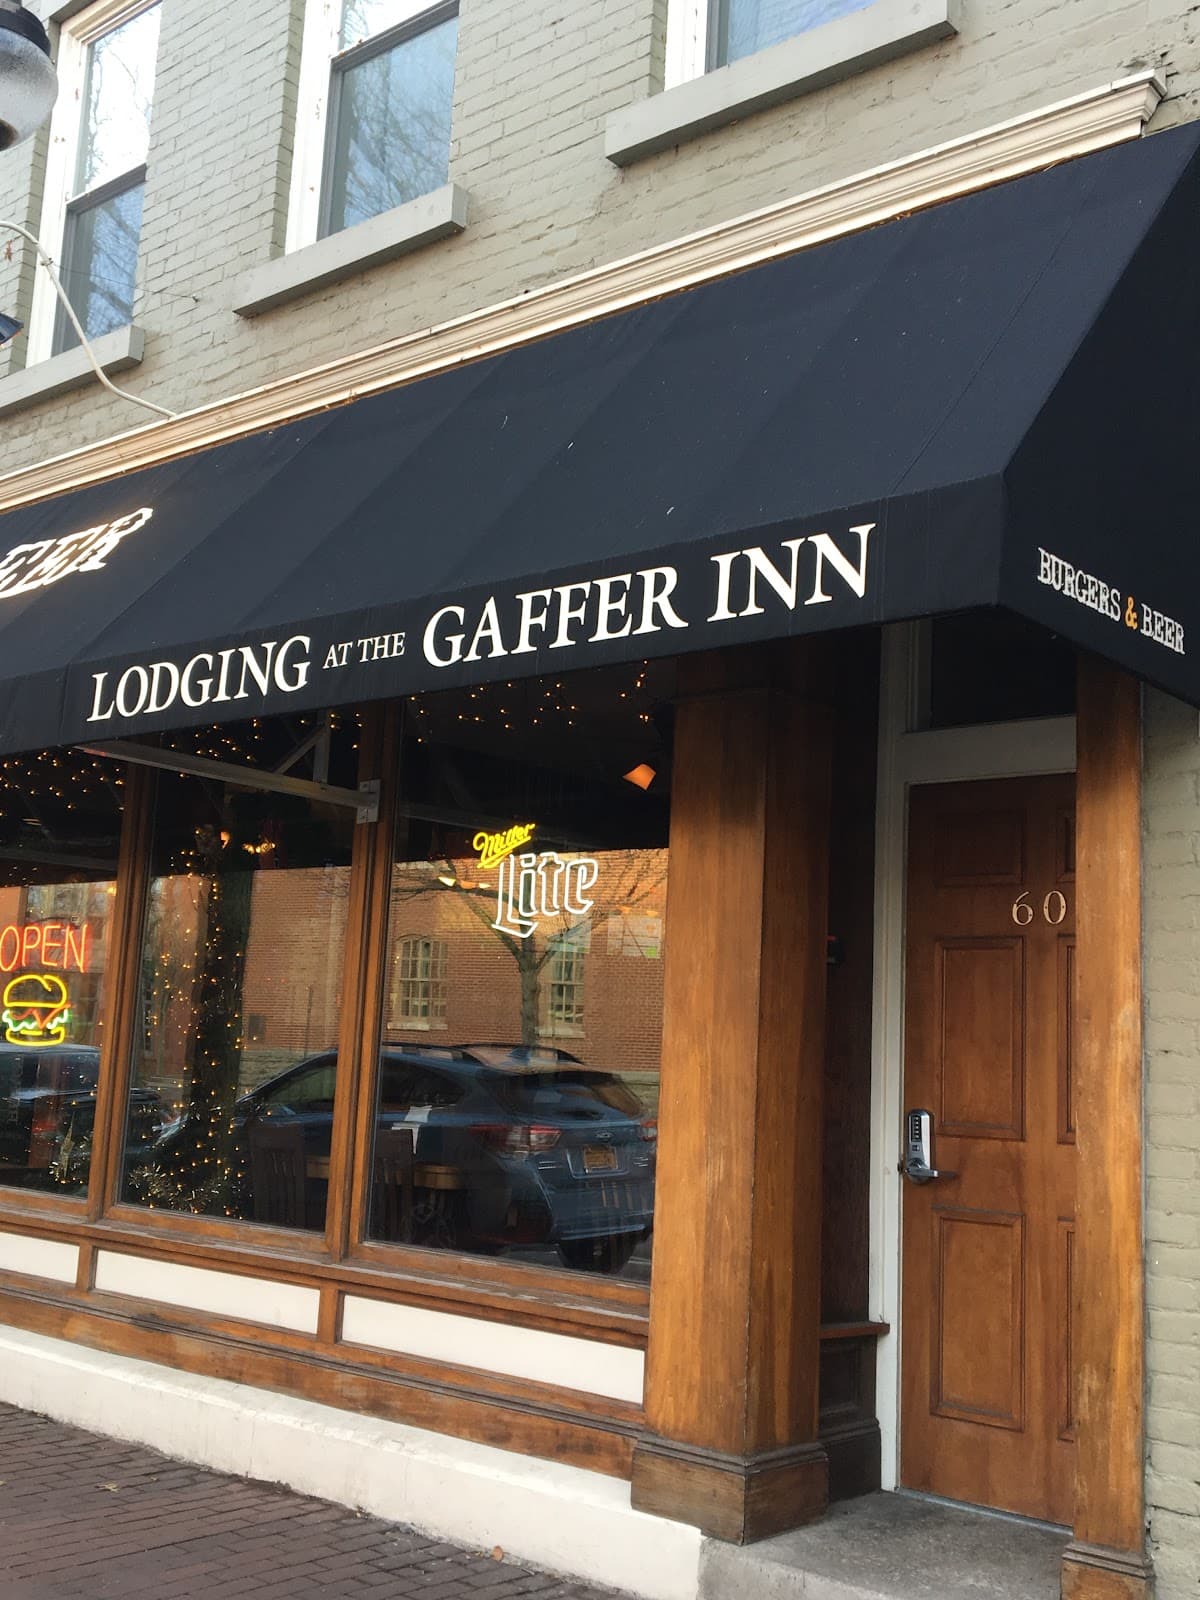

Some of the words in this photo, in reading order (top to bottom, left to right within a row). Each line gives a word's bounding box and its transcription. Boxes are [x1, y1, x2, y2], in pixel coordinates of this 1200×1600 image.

[87, 635, 311, 722] LODGING
[322, 642, 353, 669] AT
[358, 632, 405, 662] THE
[423, 565, 689, 668] GAFFER
[707, 523, 876, 622] INN
[1037, 547, 1121, 622] BURGERS
[1125, 597, 1137, 630] &
[1140, 603, 1185, 655] BEER
[473, 823, 536, 868] Miller
[491, 851, 599, 938] Lite
[1012, 890, 1067, 926] 60
[0, 924, 88, 973] OPEN
